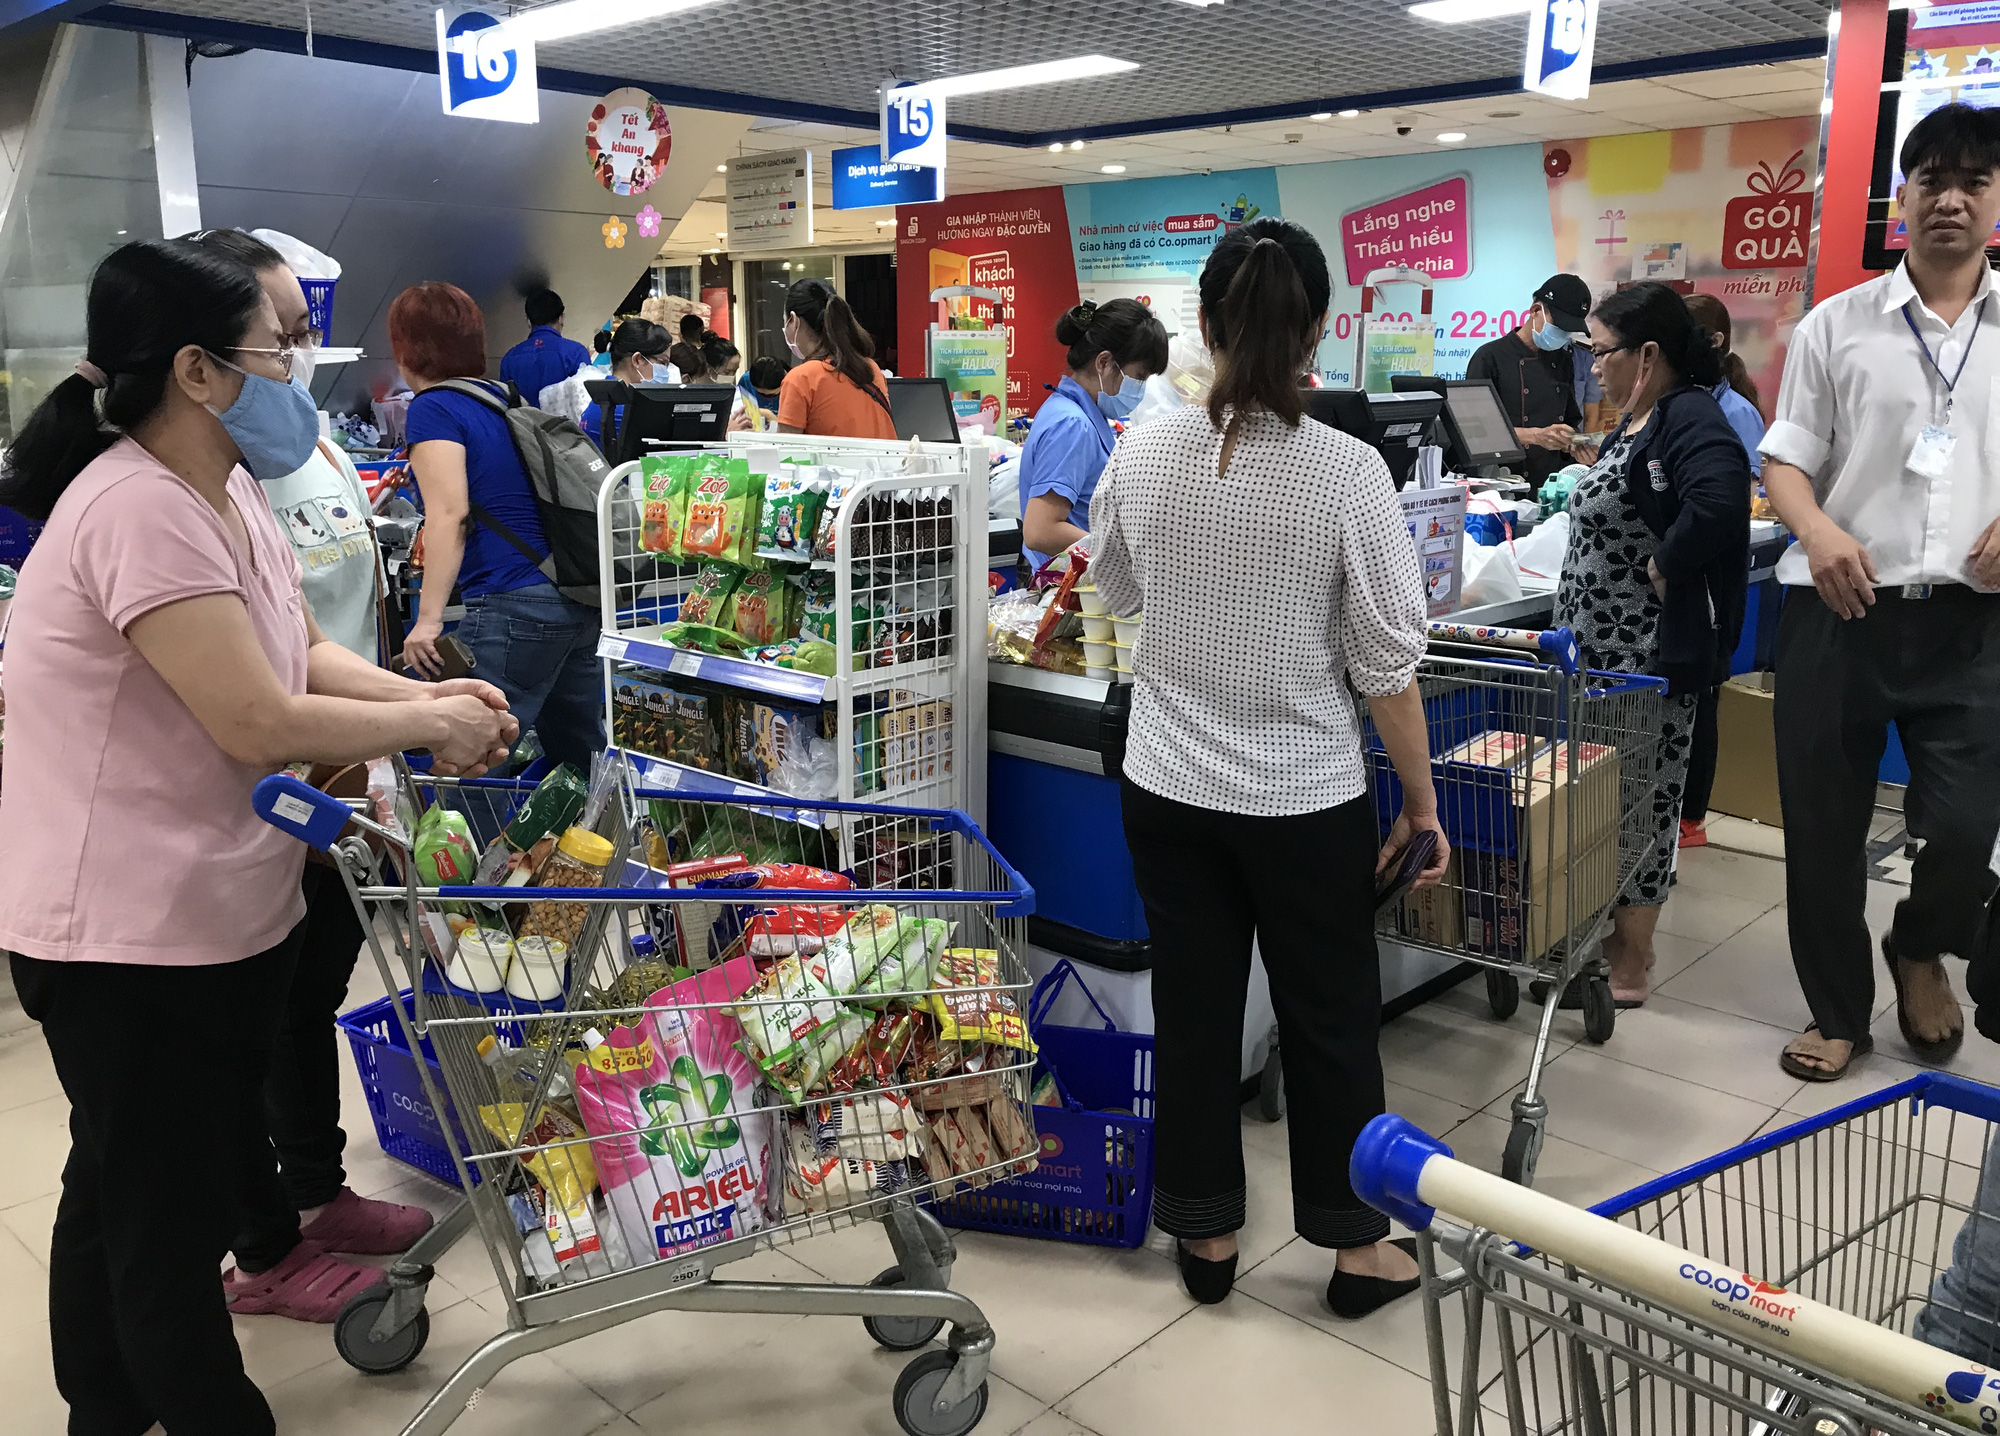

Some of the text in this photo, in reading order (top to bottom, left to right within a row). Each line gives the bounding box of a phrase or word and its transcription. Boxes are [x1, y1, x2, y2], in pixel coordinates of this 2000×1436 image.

[452, 30, 509, 82] 16
[622, 112, 639, 126] Tết
[894, 97, 929, 136] 15
[622, 128, 636, 140] An
[611, 141, 645, 157] khang
[848, 163, 898, 178] Dịch vụ giao
[946, 208, 1041, 226] GIA NHẬP THÀNH VIÊN
[1352, 199, 1456, 235] Lắng nghe
[1744, 200, 1800, 230] GÓI
[938, 220, 1051, 241] HƯỞNG NGAY ĐẶC QUYỀN
[1080, 214, 1215, 236] Nhà mình cứ việc mua sắm
[1080, 242, 1100, 252] Giao
[1103, 239, 1126, 251] hàng
[1130, 237, 1141, 248] đã
[1144, 238, 1155, 248] có
[1158, 234, 1210, 248] Co.opmart
[1355, 226, 1453, 258] Thấu hiểu
[1735, 230, 1804, 261] QUÀ
[1414, 258, 1454, 272] chia
[975, 266, 1015, 283] khách
[1723, 274, 1771, 294] miễn
[1325, 370, 1349, 382] Tổng
[698, 477, 729, 494] Zoo
[614, 689, 639, 706] JUNGLE
[644, 697, 671, 713] JUNGLE
[676, 702, 704, 719] JUNGLE
[740, 714, 749, 758] JUNGLE
[706, 1156, 748, 1180] POWER GEL
[653, 1164, 758, 1221] ARIEL
[1045, 1183, 1061, 1192] mọi
[1064, 1185, 1082, 1194] nhà
[664, 1214, 724, 1243] MATIC
[672, 1269, 700, 1282] 2507
[1712, 1299, 1790, 1337] bạn của mọi nhà
